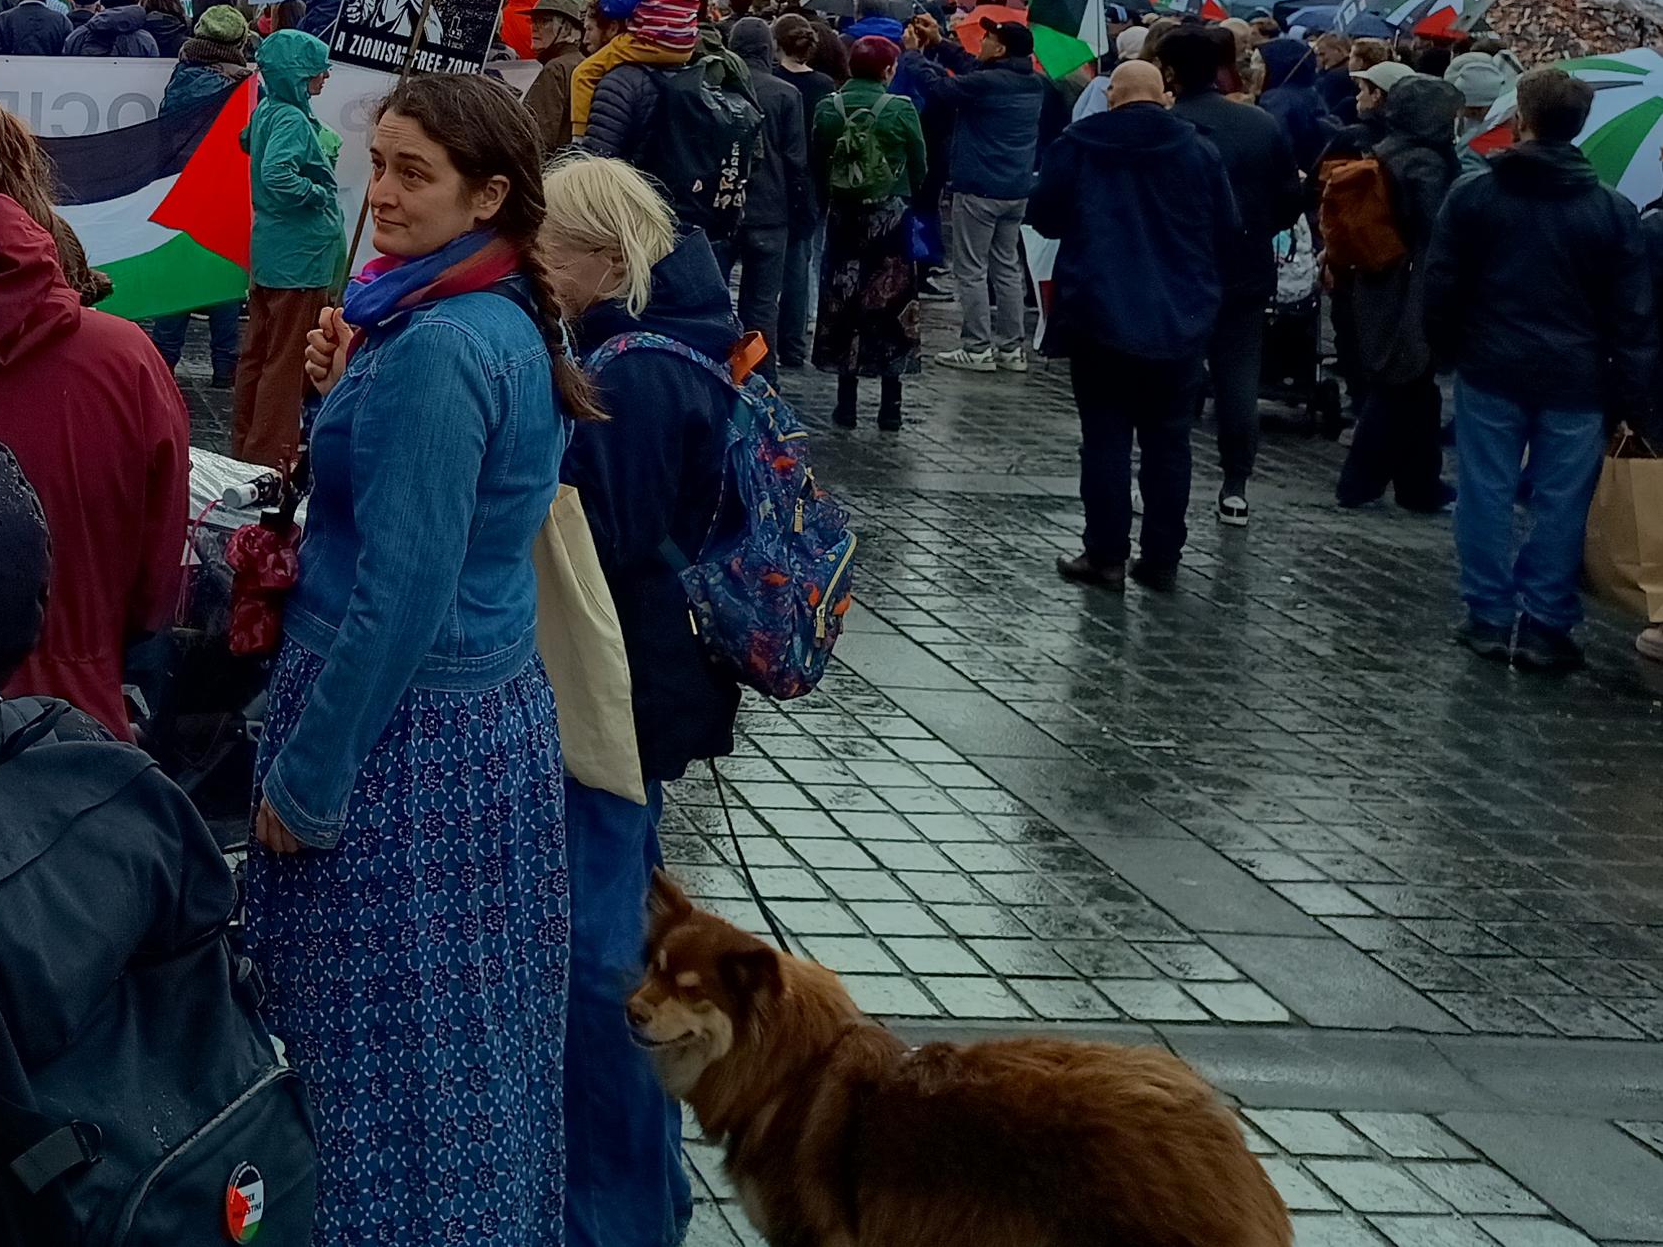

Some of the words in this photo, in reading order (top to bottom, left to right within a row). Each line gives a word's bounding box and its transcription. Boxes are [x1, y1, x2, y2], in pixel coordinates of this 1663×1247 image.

[335, 32, 344, 52] A
[348, 35, 408, 66] ZIONISM
[411, 49, 445, 75] FREE
